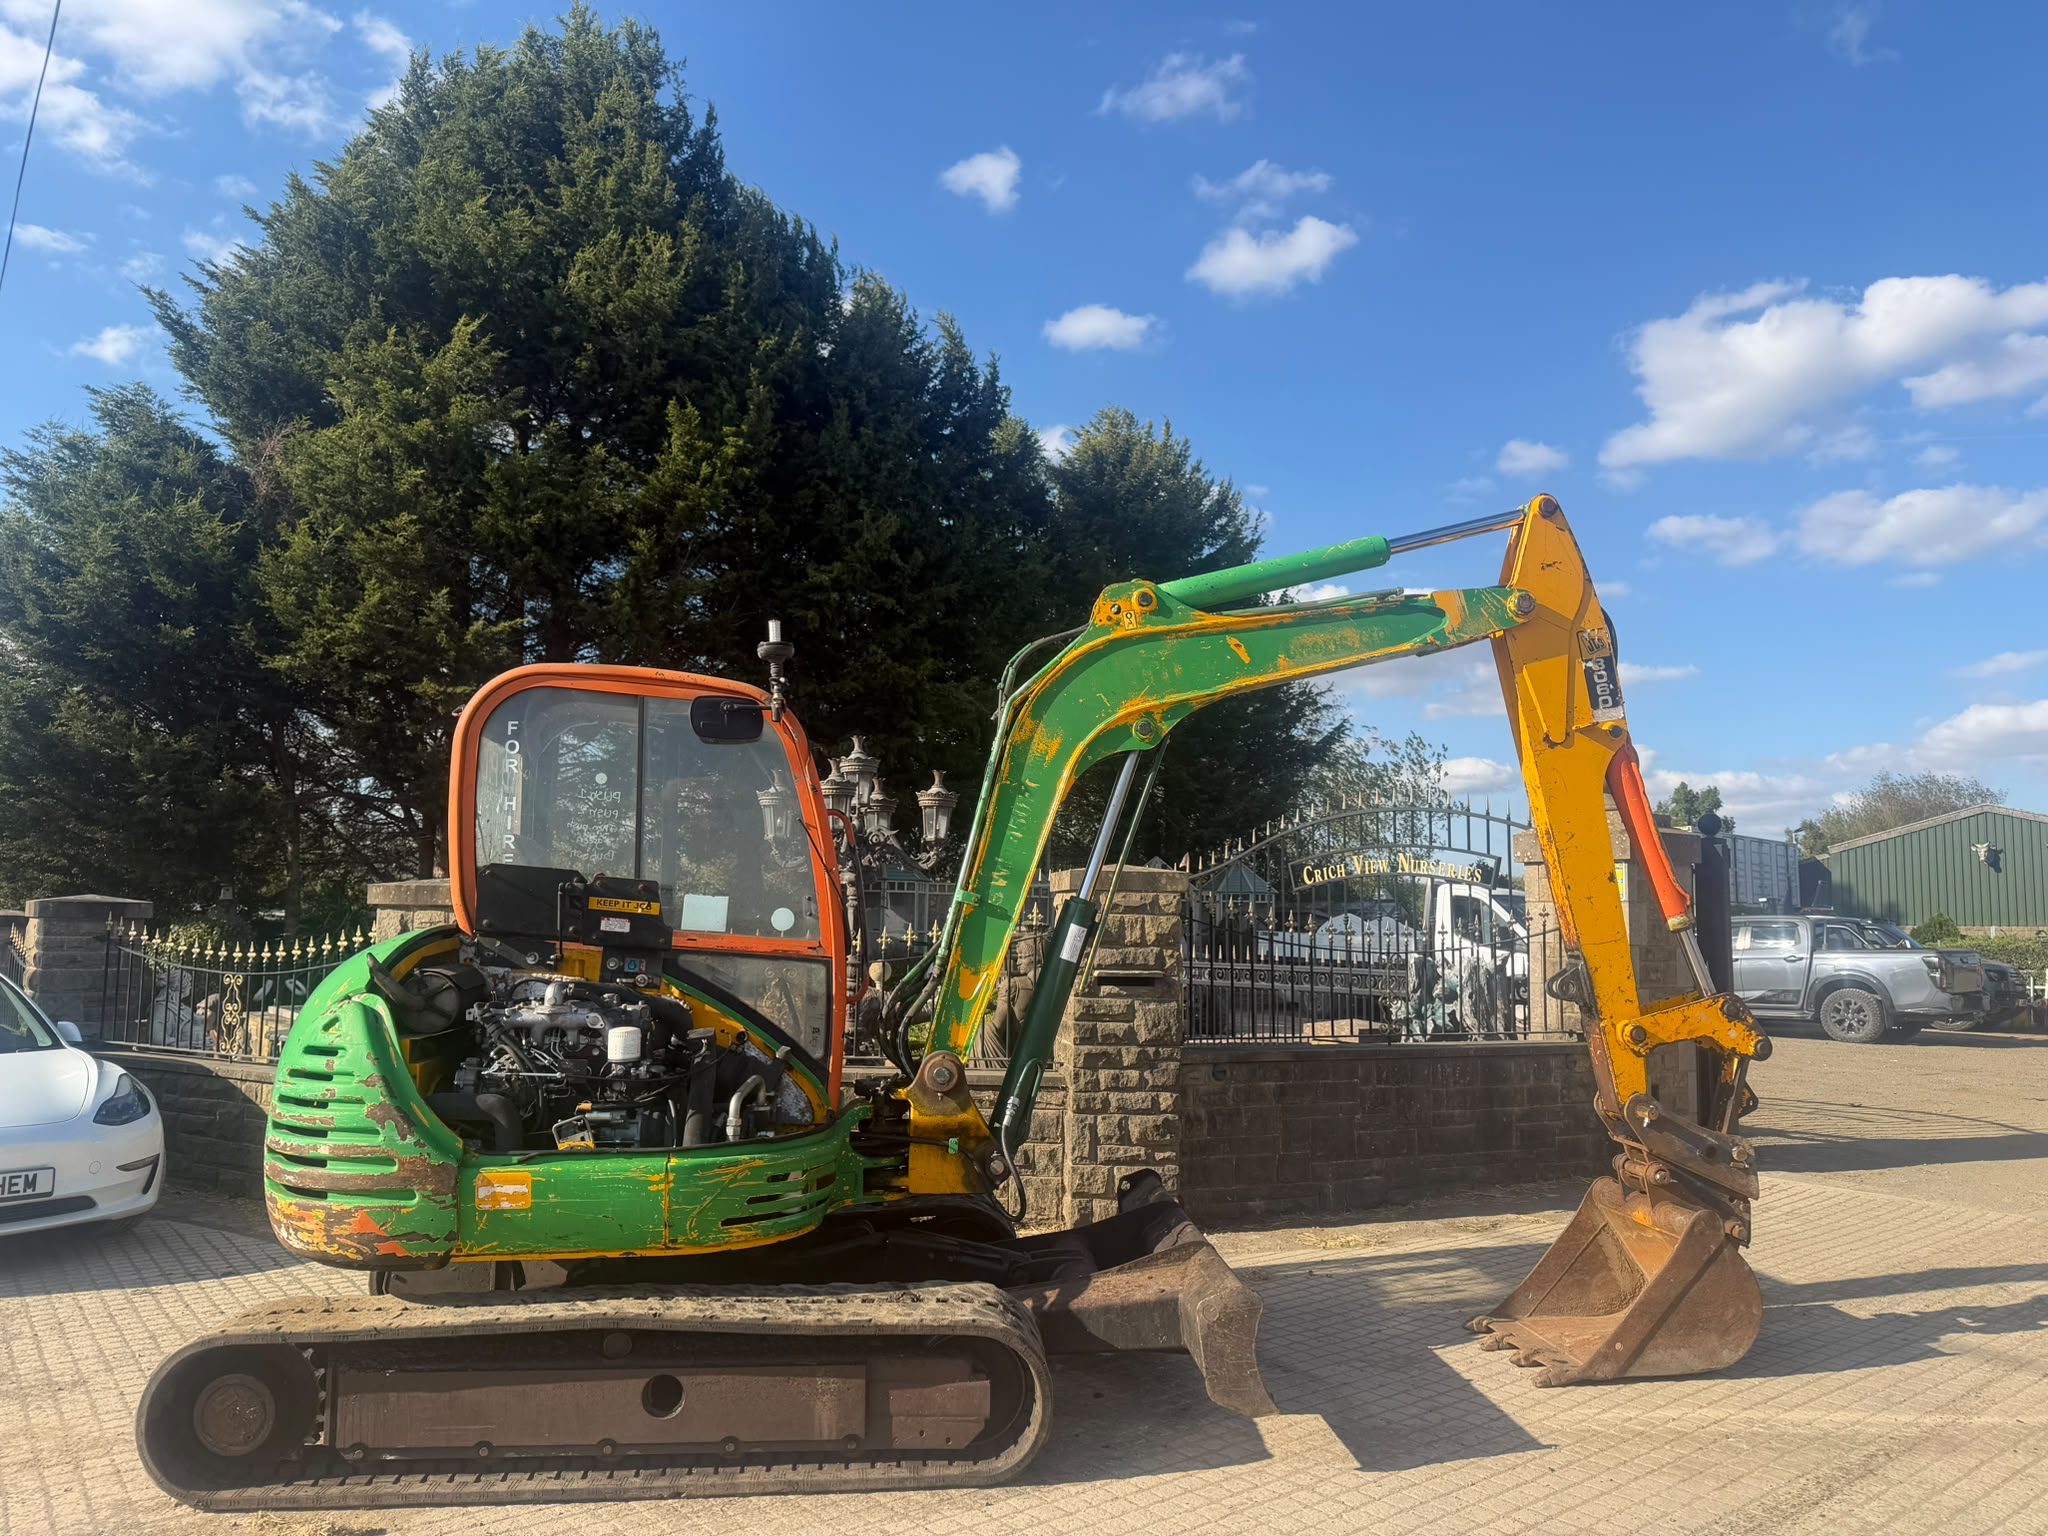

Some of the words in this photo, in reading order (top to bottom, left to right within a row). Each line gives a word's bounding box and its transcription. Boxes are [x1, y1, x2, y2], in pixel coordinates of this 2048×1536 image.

[505, 720, 520, 773] FOR
[596, 898, 620, 908] KEEP
[622, 901, 632, 909] IT
